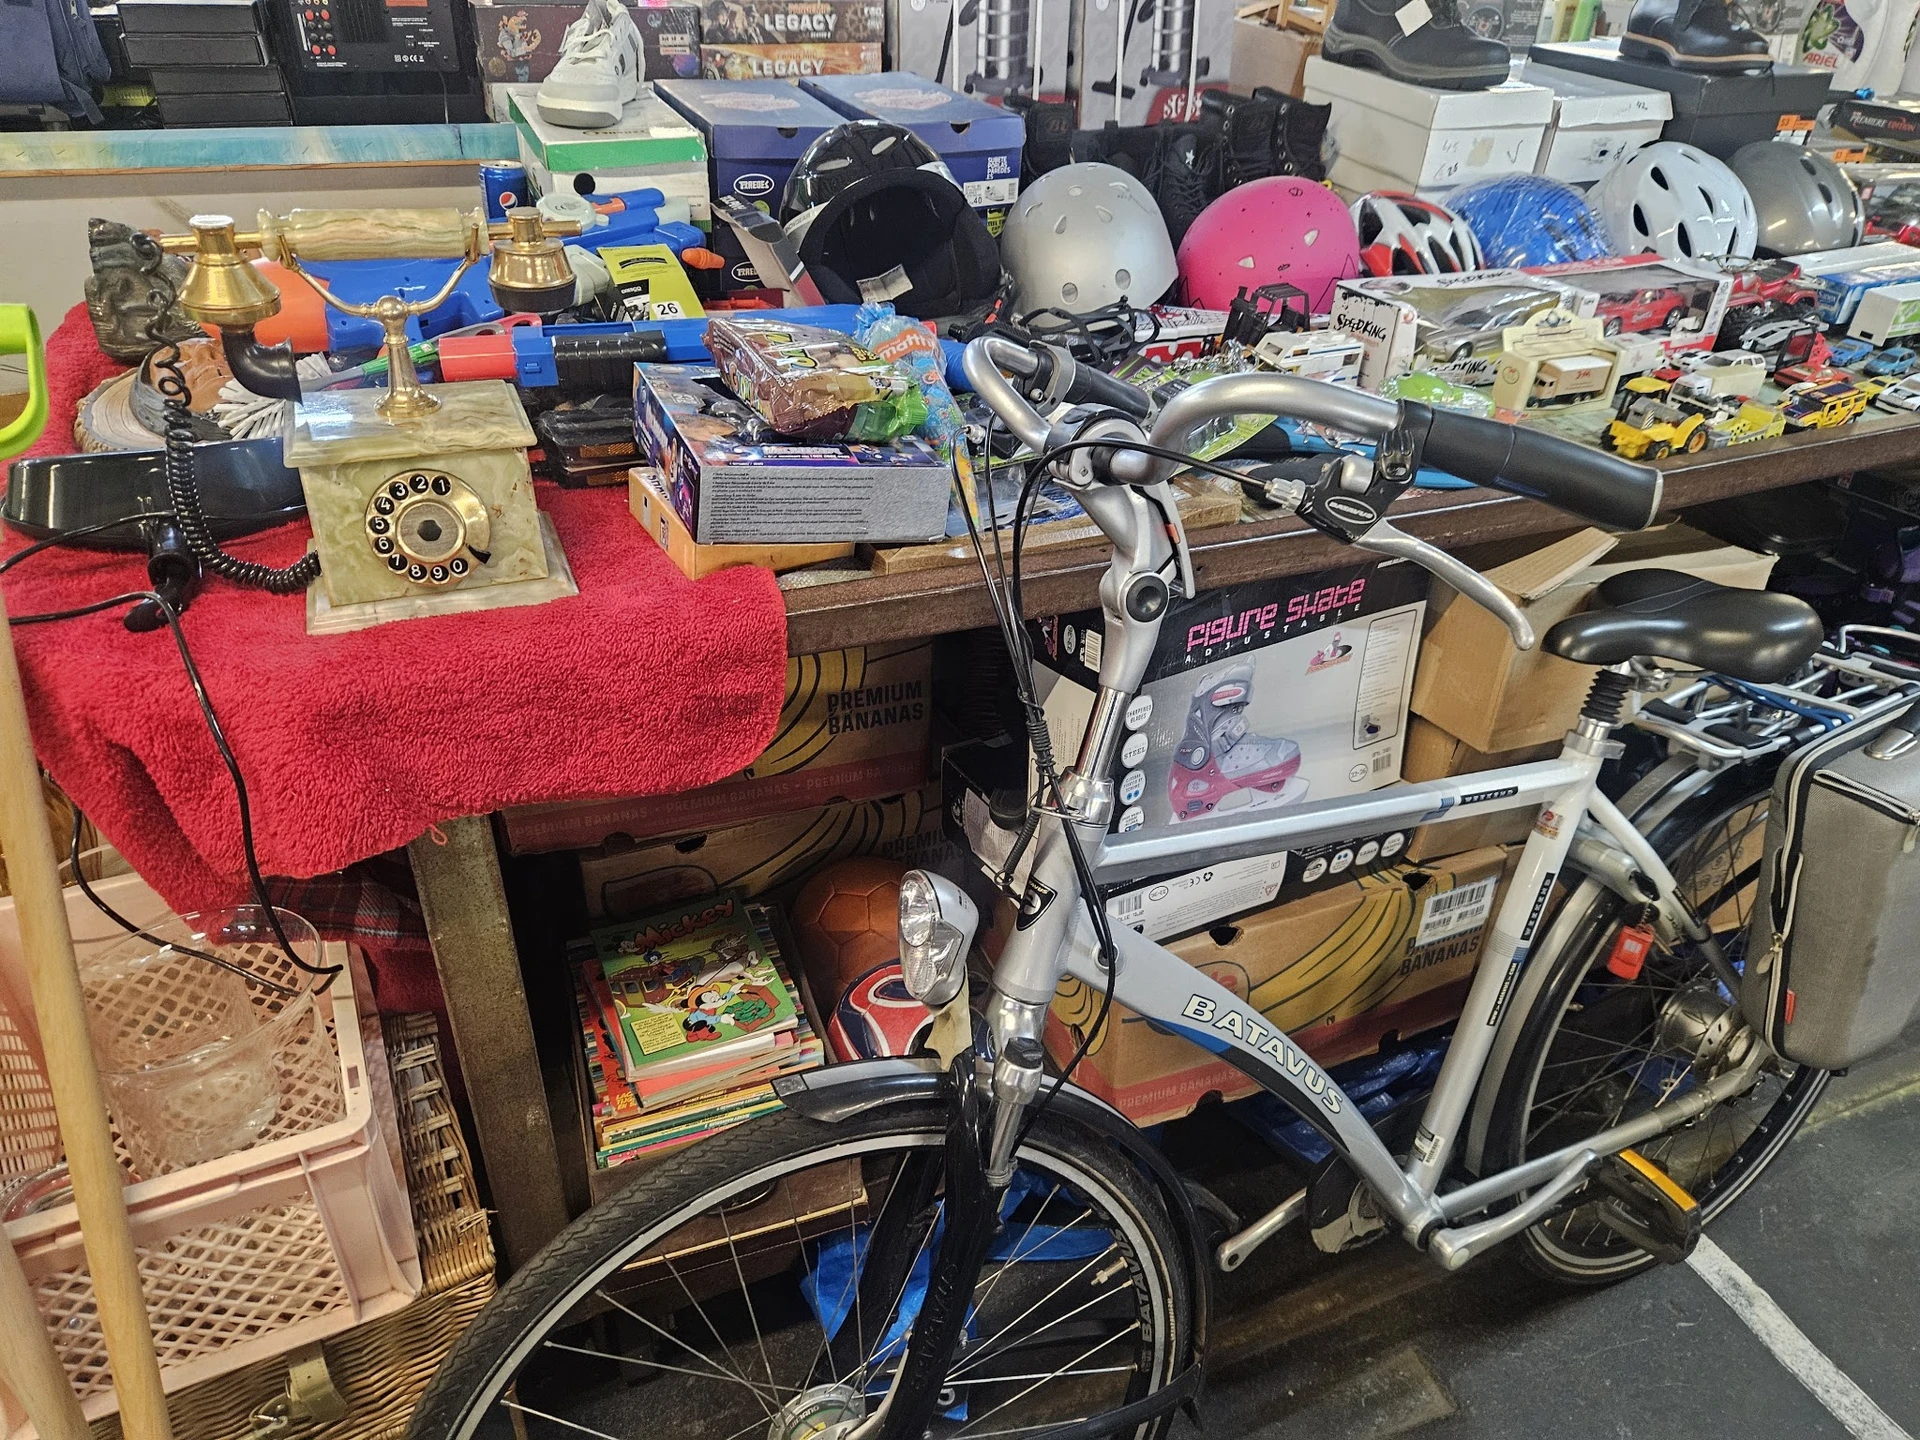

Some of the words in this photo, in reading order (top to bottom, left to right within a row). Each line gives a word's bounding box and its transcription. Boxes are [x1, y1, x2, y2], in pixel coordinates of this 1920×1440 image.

[764, 14, 838, 32] LEGACY
[752, 59, 825, 76] LEGACY
[1804, 52, 1838, 68] ARIEL
[973, 196, 982, 204] 40
[657, 303, 679, 316] 26
[395, 484, 406, 497] 3
[415, 476, 427, 490] 2
[439, 480, 446, 492] 1
[378, 497, 391, 511] 4
[1328, 501, 1374, 519] BATAVUS
[374, 516, 385, 530] 5
[377, 537, 389, 550] 6
[391, 553, 401, 566] 7
[452, 560, 462, 573] 0
[411, 564, 422, 578] 8
[432, 567, 443, 579] 9
[827, 680, 922, 713] PREMIUM
[828, 702, 924, 735] BANANAS
[1123, 747, 1146, 760] STEEL
[665, 792, 728, 814] PREMIUM
[729, 783, 790, 804] BANANAS
[806, 769, 865, 790] PREMIUM
[1523, 875, 1553, 940] WEEKEND
[634, 898, 735, 956] Mickey
[1399, 935, 1481, 976] BANANAS
[1181, 993, 1343, 1114] BATAVUS
[1118, 1085, 1177, 1110] PREMIUM
[1179, 1071, 1237, 1095] BANANAS
[1110, 1227, 1153, 1343] BATAVUS
